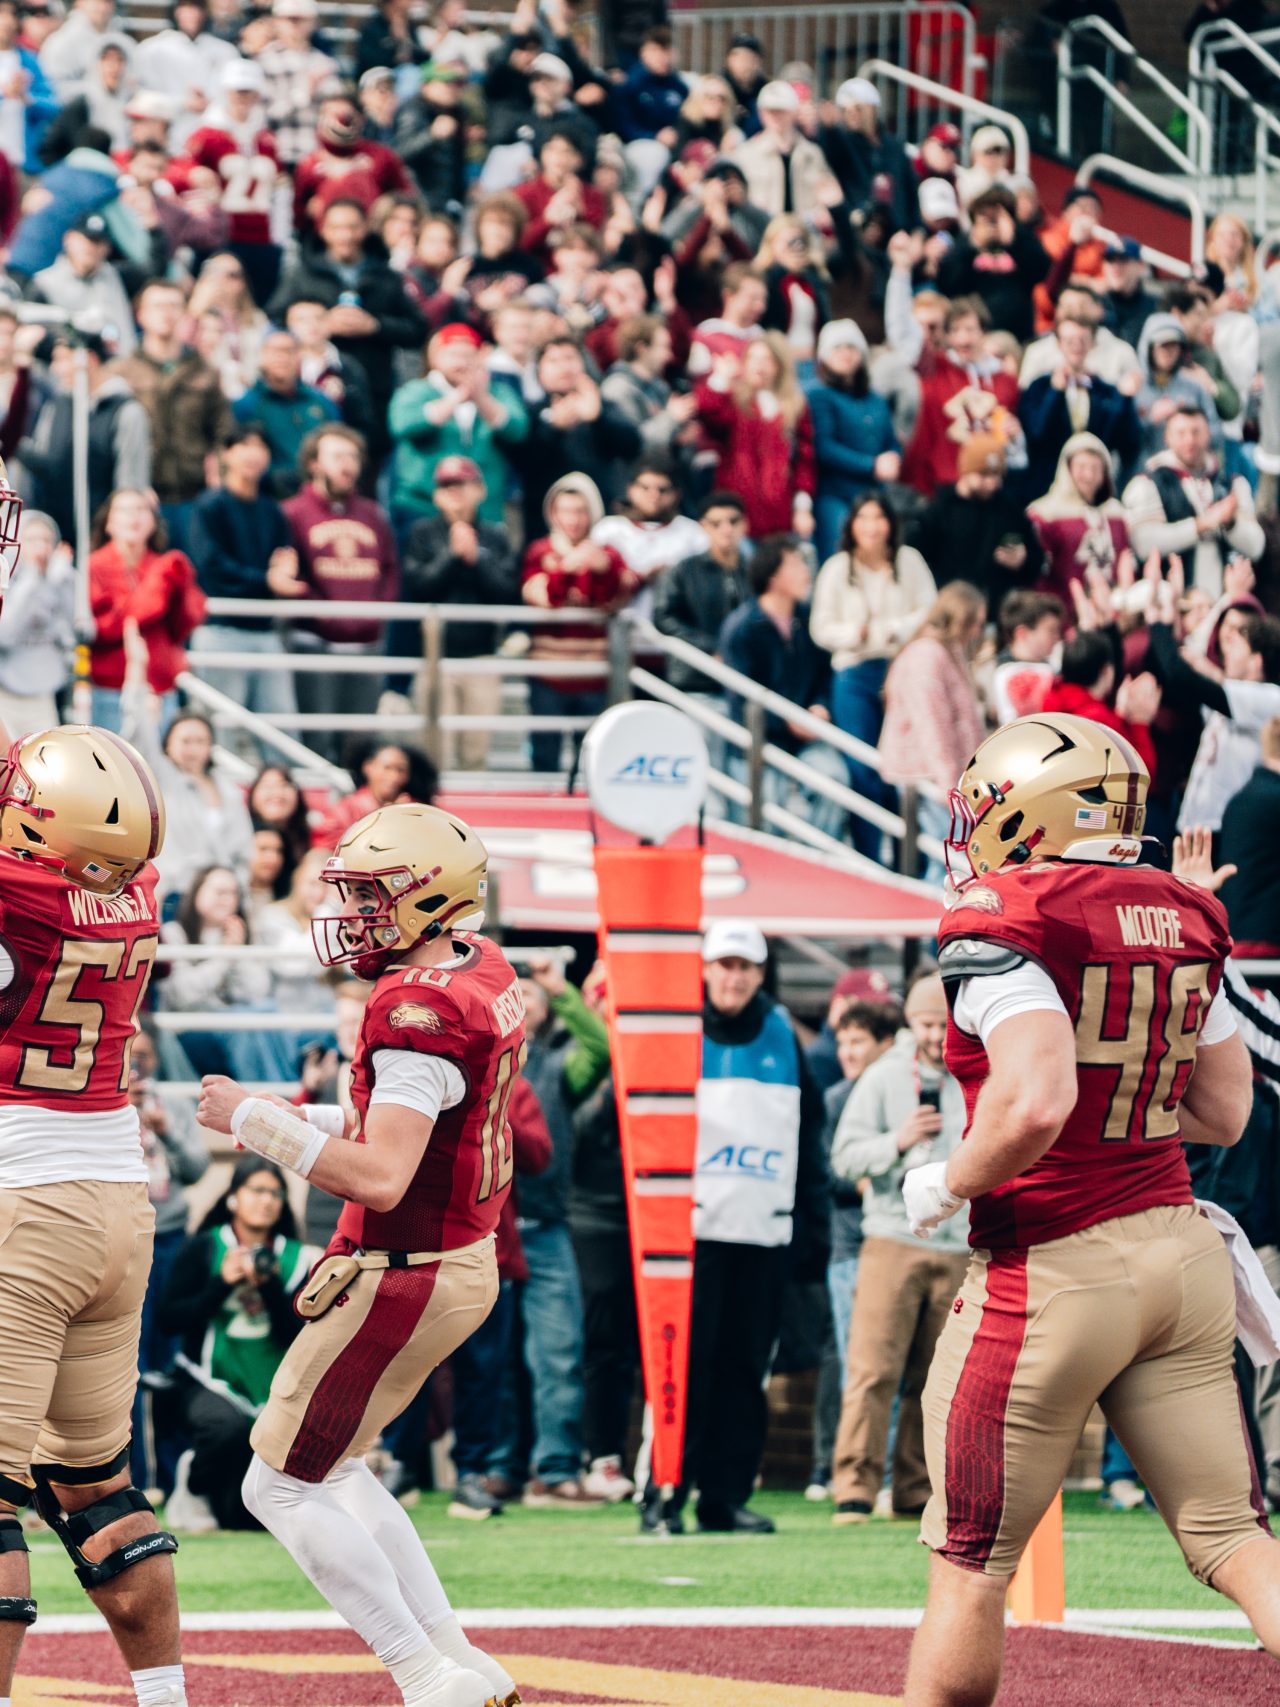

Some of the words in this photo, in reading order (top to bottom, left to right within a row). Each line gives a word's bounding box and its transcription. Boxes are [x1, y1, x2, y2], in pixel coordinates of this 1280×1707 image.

[616, 755, 698, 781] ACC
[1112, 805, 1144, 831] 48
[67, 887, 141, 927] WILLIAMS
[1116, 905, 1185, 949] MOORE
[17, 934, 159, 1094] 57
[1076, 962, 1213, 1142] 48
[700, 1144, 784, 1174] ACC
[124, 1537, 165, 1561] DONJOY
